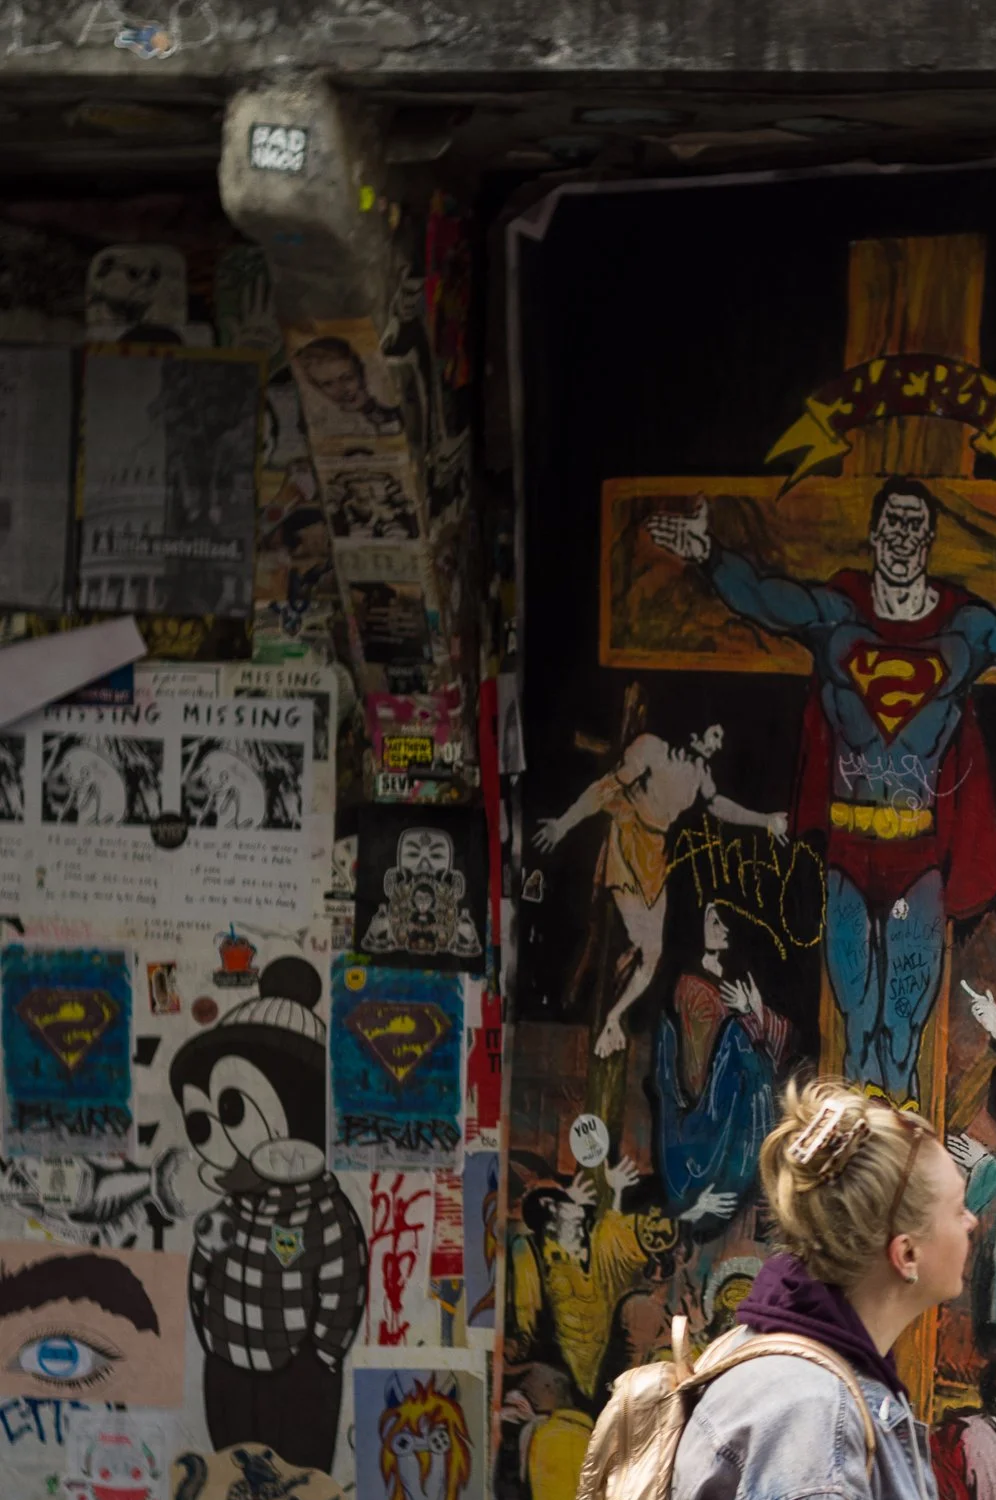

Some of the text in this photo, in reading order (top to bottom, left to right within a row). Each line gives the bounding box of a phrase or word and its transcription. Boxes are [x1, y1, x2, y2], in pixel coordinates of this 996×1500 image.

[241, 670, 322, 687] MISSING
[44, 703, 303, 728] MISSING MISSING
[892, 951, 928, 976] HAIL
[888, 964, 931, 1001] SATAN
[573, 1118, 597, 1137] YOU
